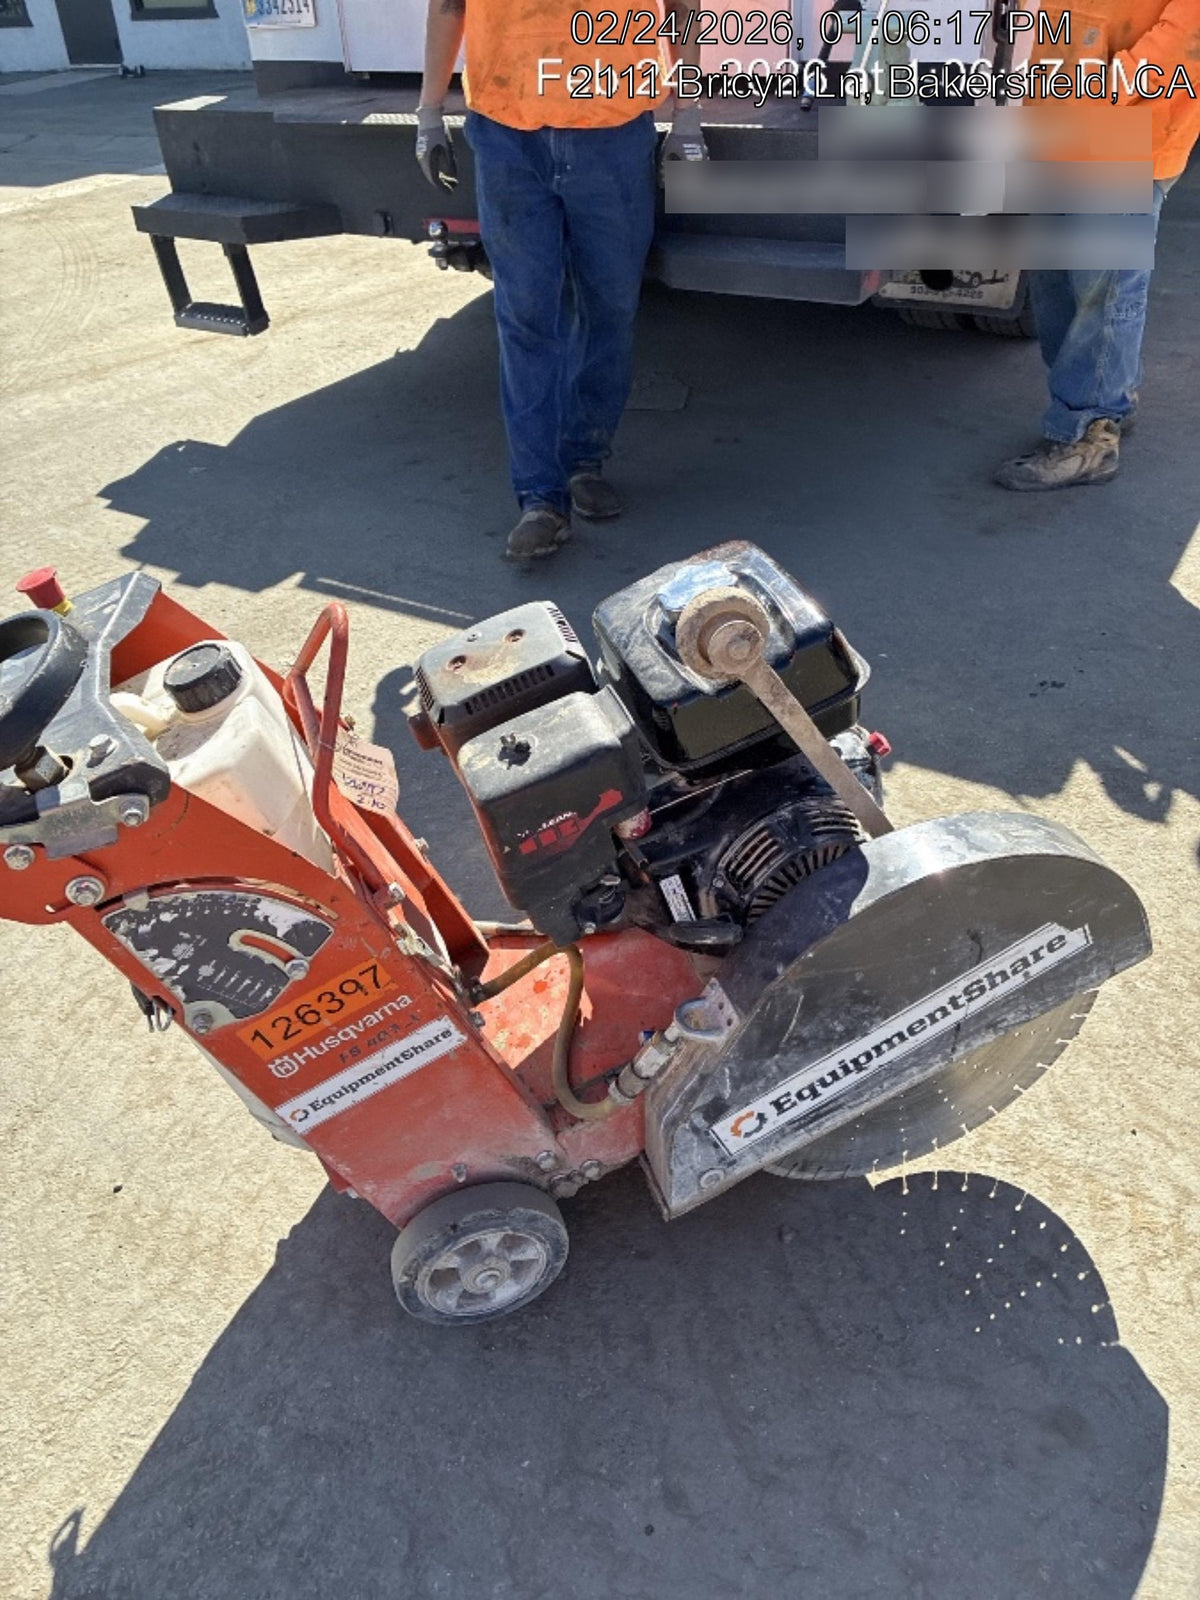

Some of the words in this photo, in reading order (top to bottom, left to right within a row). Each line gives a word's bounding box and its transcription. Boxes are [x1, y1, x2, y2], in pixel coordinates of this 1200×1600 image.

[250, 963, 382, 1050] 126397
[293, 993, 413, 1066] Husqvarna
[769, 930, 1068, 1116] EquipmentShare
[308, 1027, 454, 1112] EquipmentShare
